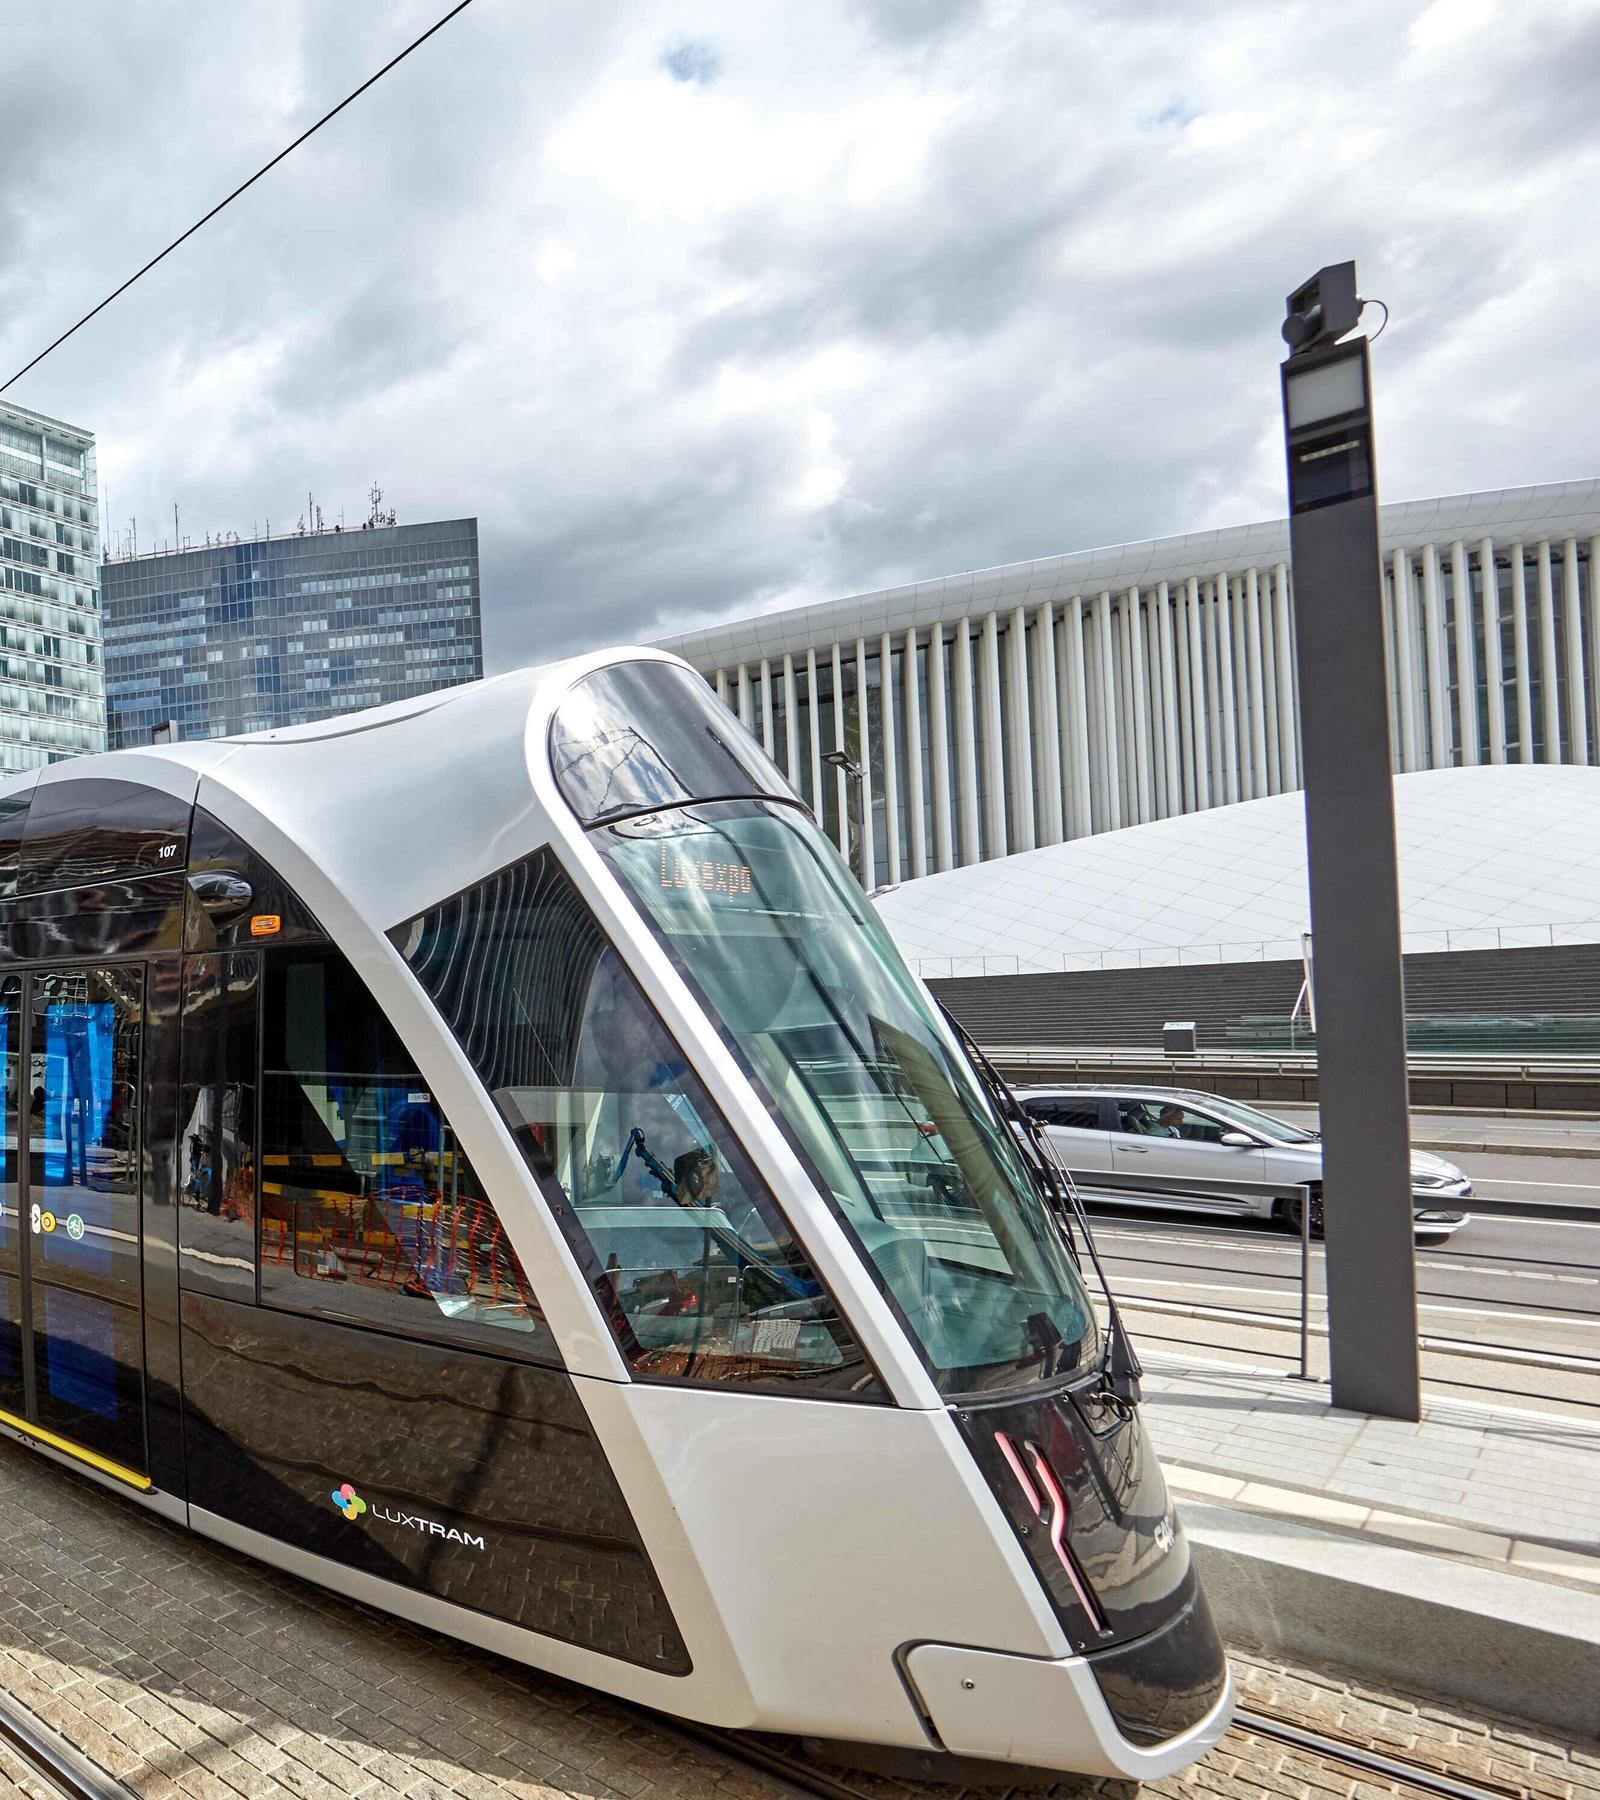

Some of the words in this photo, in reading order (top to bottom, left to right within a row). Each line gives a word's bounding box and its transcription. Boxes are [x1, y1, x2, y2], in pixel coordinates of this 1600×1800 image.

[158, 844, 177, 859] 107
[661, 842, 751, 902] Luxexpo
[372, 1503, 485, 1551] LUXTRAM
